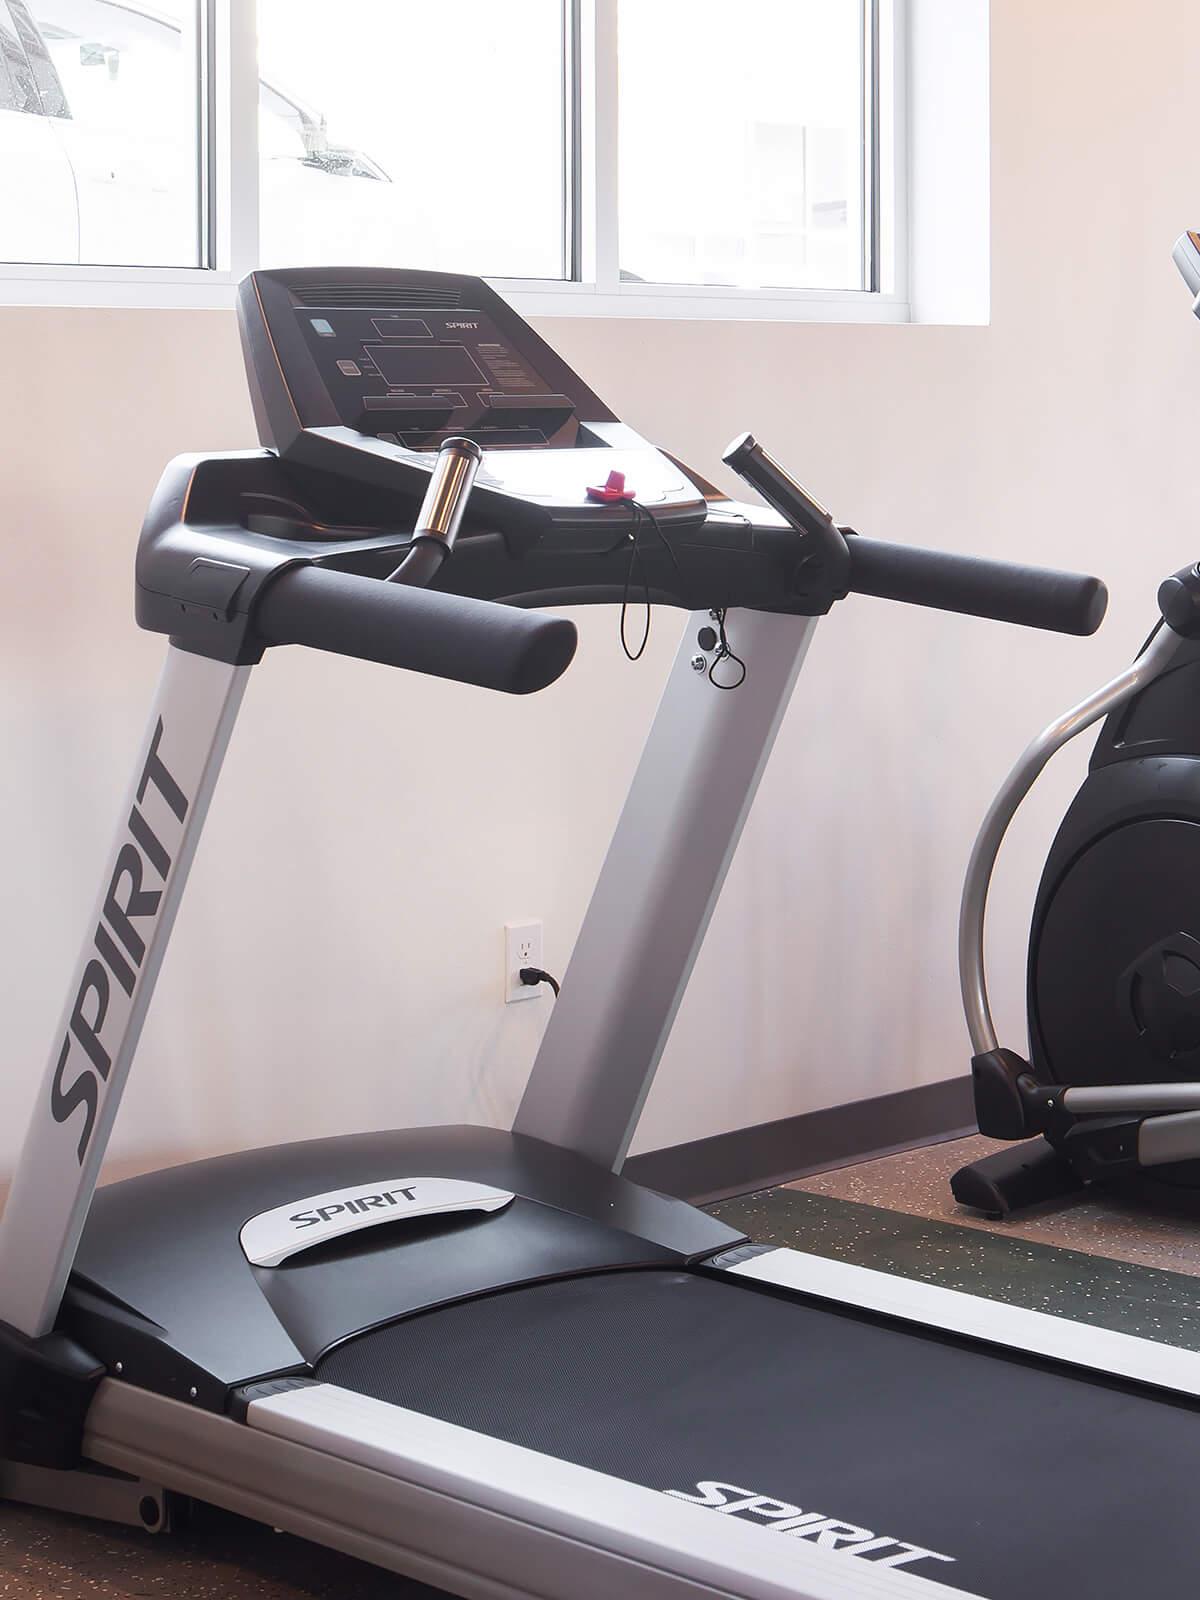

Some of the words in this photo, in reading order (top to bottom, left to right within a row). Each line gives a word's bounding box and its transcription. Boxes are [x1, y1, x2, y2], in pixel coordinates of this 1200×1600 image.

[51, 714, 188, 1167] SPIRIT
[288, 1186, 417, 1230] SPIRIT
[662, 1480, 957, 1568] SPIRIT
